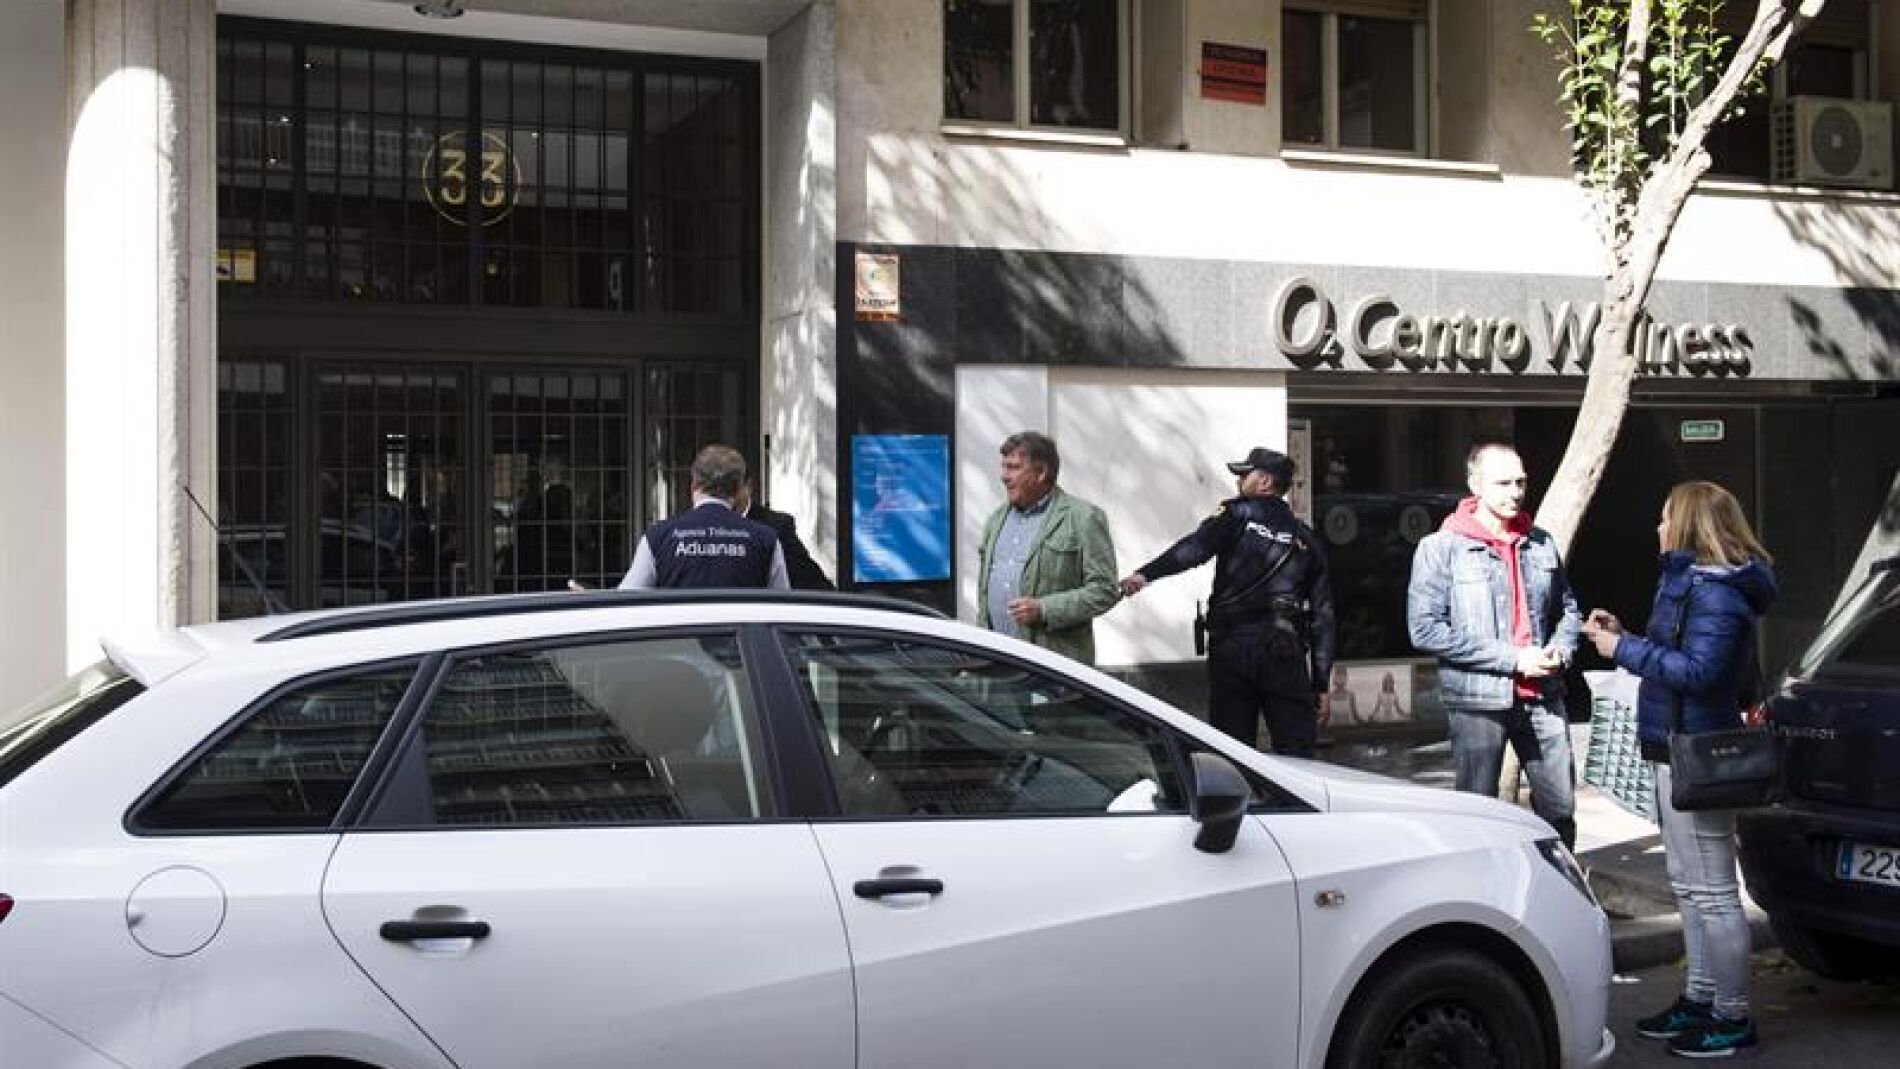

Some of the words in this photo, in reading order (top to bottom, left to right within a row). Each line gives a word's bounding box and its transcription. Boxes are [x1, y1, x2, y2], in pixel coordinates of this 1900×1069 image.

[441, 150, 505, 208] 33
[1351, 293, 1530, 364] Centro
[1538, 300, 1753, 366] Wlness
[674, 540, 747, 557] Aduanas
